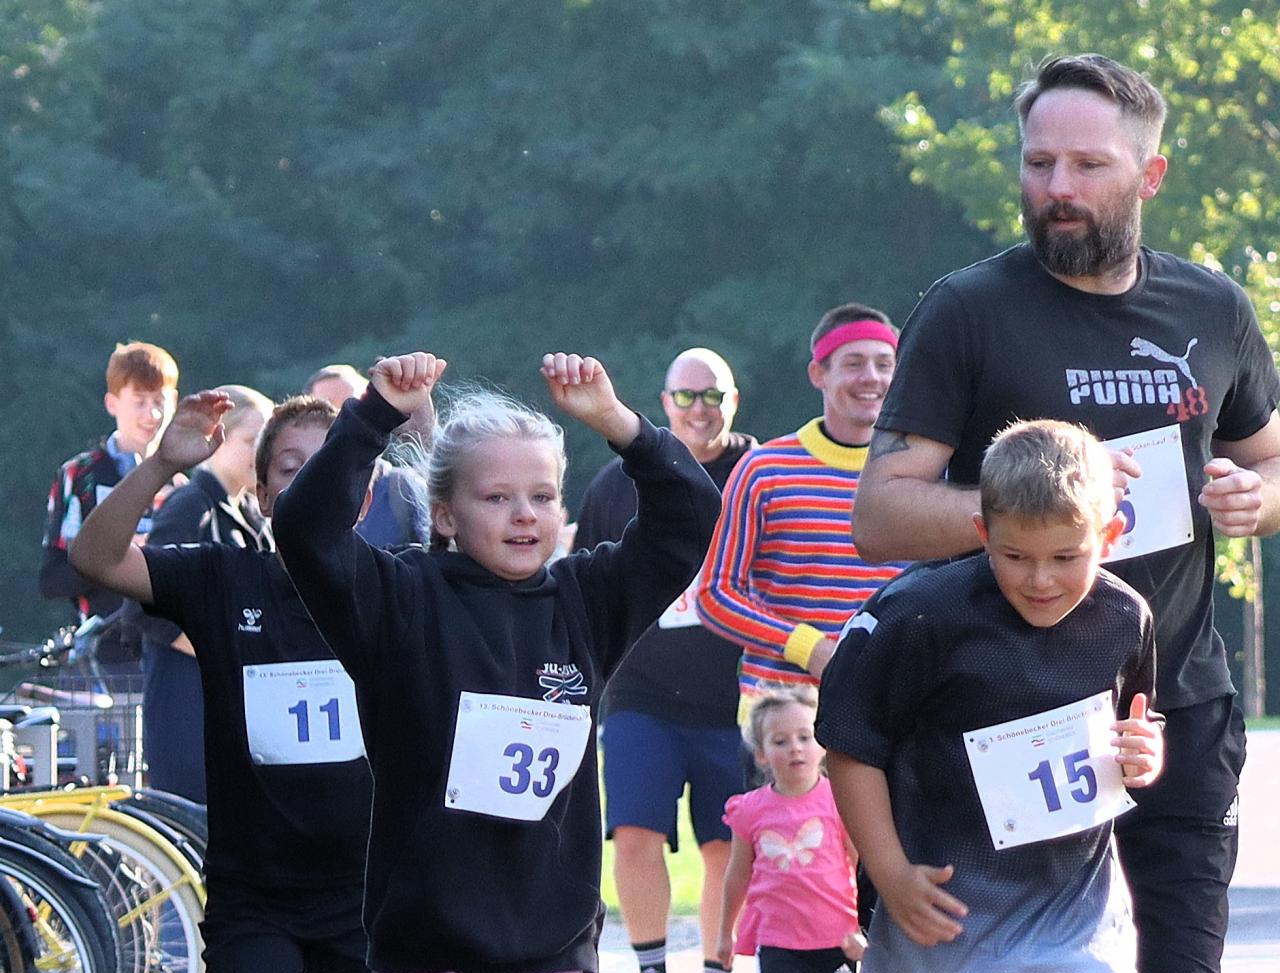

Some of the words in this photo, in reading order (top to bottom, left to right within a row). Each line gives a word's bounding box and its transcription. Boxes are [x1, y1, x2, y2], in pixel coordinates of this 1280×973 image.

[1065, 368, 1181, 405] PUMA
[288, 698, 341, 743] 11
[492, 703, 542, 718] Schönebecker
[996, 723, 1049, 743] Schönebecker
[499, 742, 560, 798] 33
[1028, 749, 1098, 813] 15
